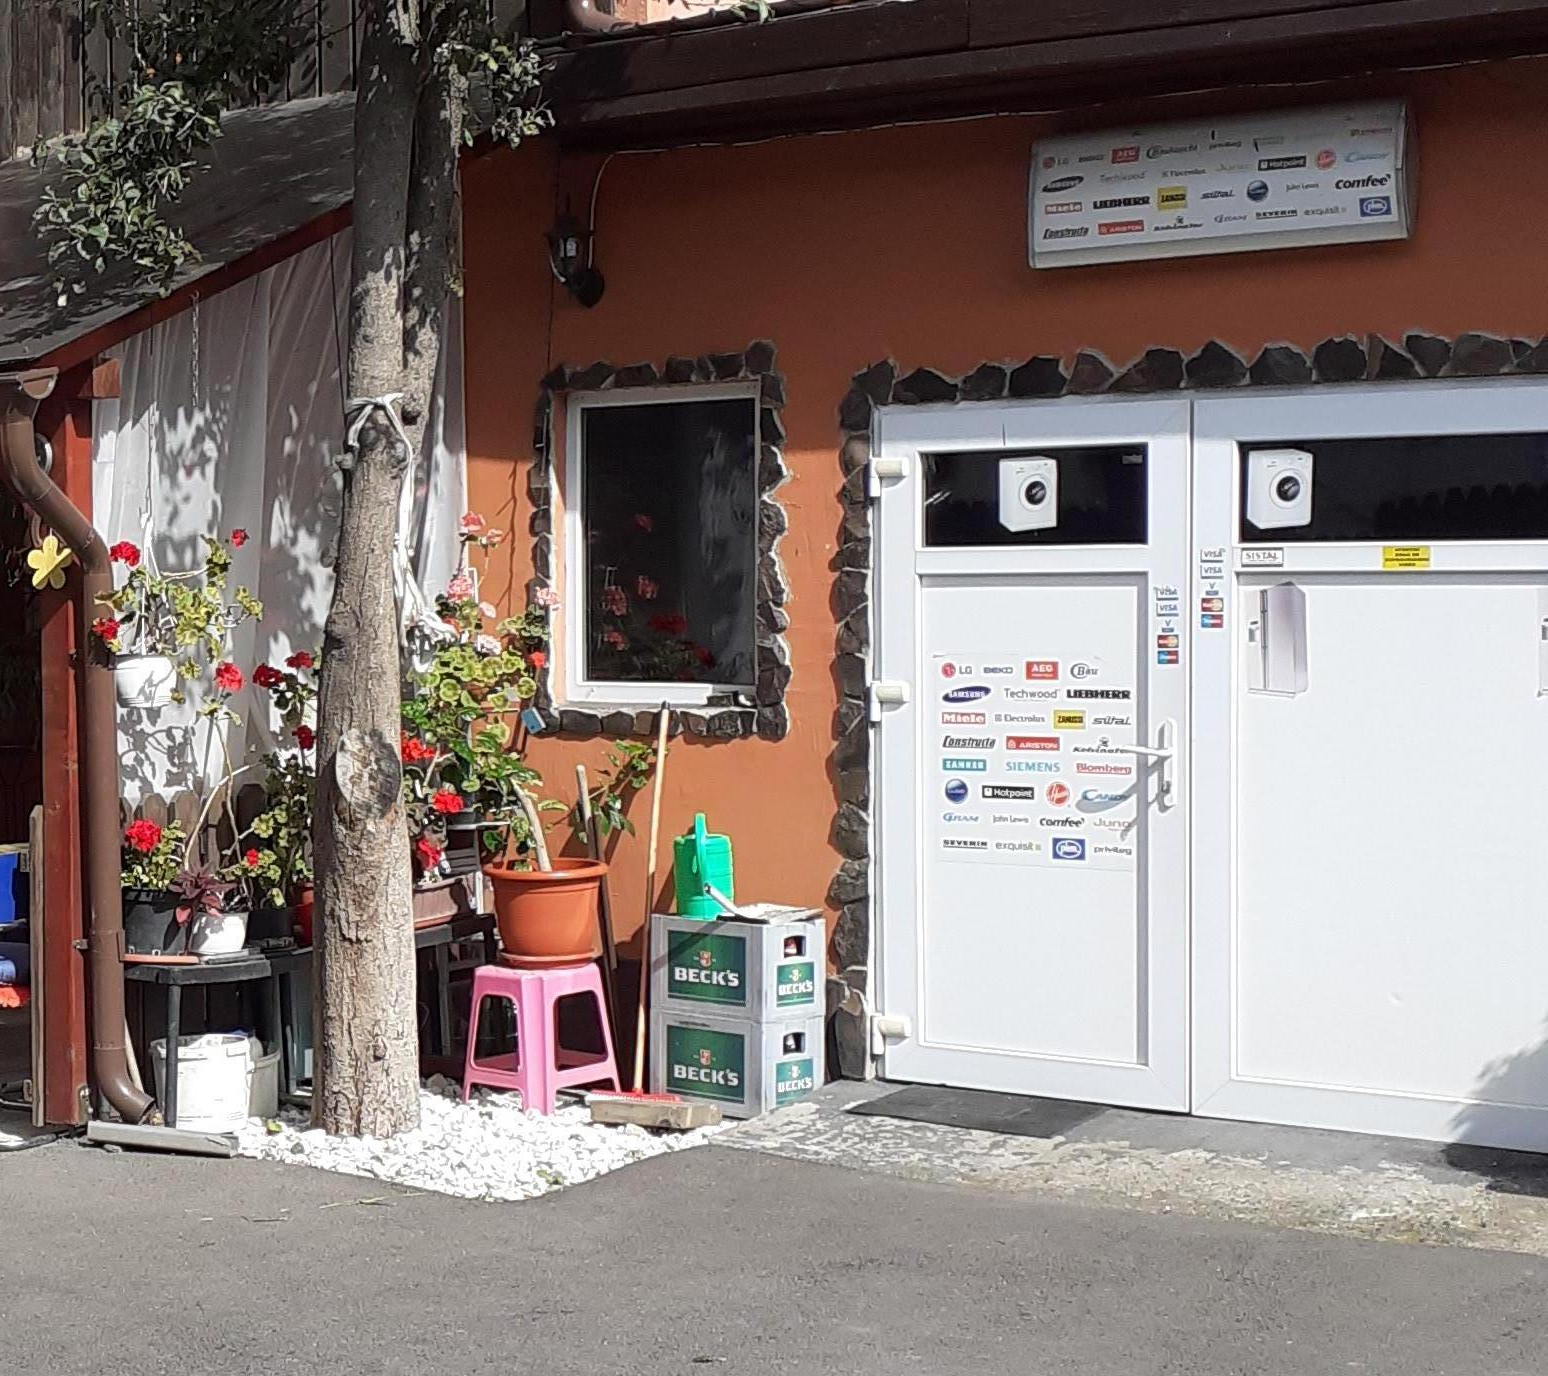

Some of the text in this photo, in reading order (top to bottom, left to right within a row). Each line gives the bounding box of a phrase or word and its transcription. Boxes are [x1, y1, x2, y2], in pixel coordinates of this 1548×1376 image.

[1203, 566, 1222, 574] VISA
[1160, 604, 1178, 612] VISA
[959, 665, 973, 675] LG
[1031, 663, 1054, 673] AEG
[1004, 688, 1058, 699] Techwood
[1066, 689, 1131, 700] LIEBHERR
[942, 713, 986, 724] Miele
[1004, 713, 1046, 723] Electrolux
[942, 735, 997, 749] Constructa
[1018, 741, 1059, 750] ARISTON
[1005, 761, 1061, 773] SIEMENS
[1076, 762, 1132, 775] Blomberg
[993, 787, 1034, 800] Hotpoint
[992, 815, 1030, 824] John Lewis
[943, 839, 988, 849] SEVERIN
[995, 841, 1036, 852] exquisit
[674, 966, 740, 987] BECK'S
[778, 979, 813, 996] BECK'S
[673, 1064, 739, 1087] BECK'S
[777, 1077, 813, 1093] BECK'S
